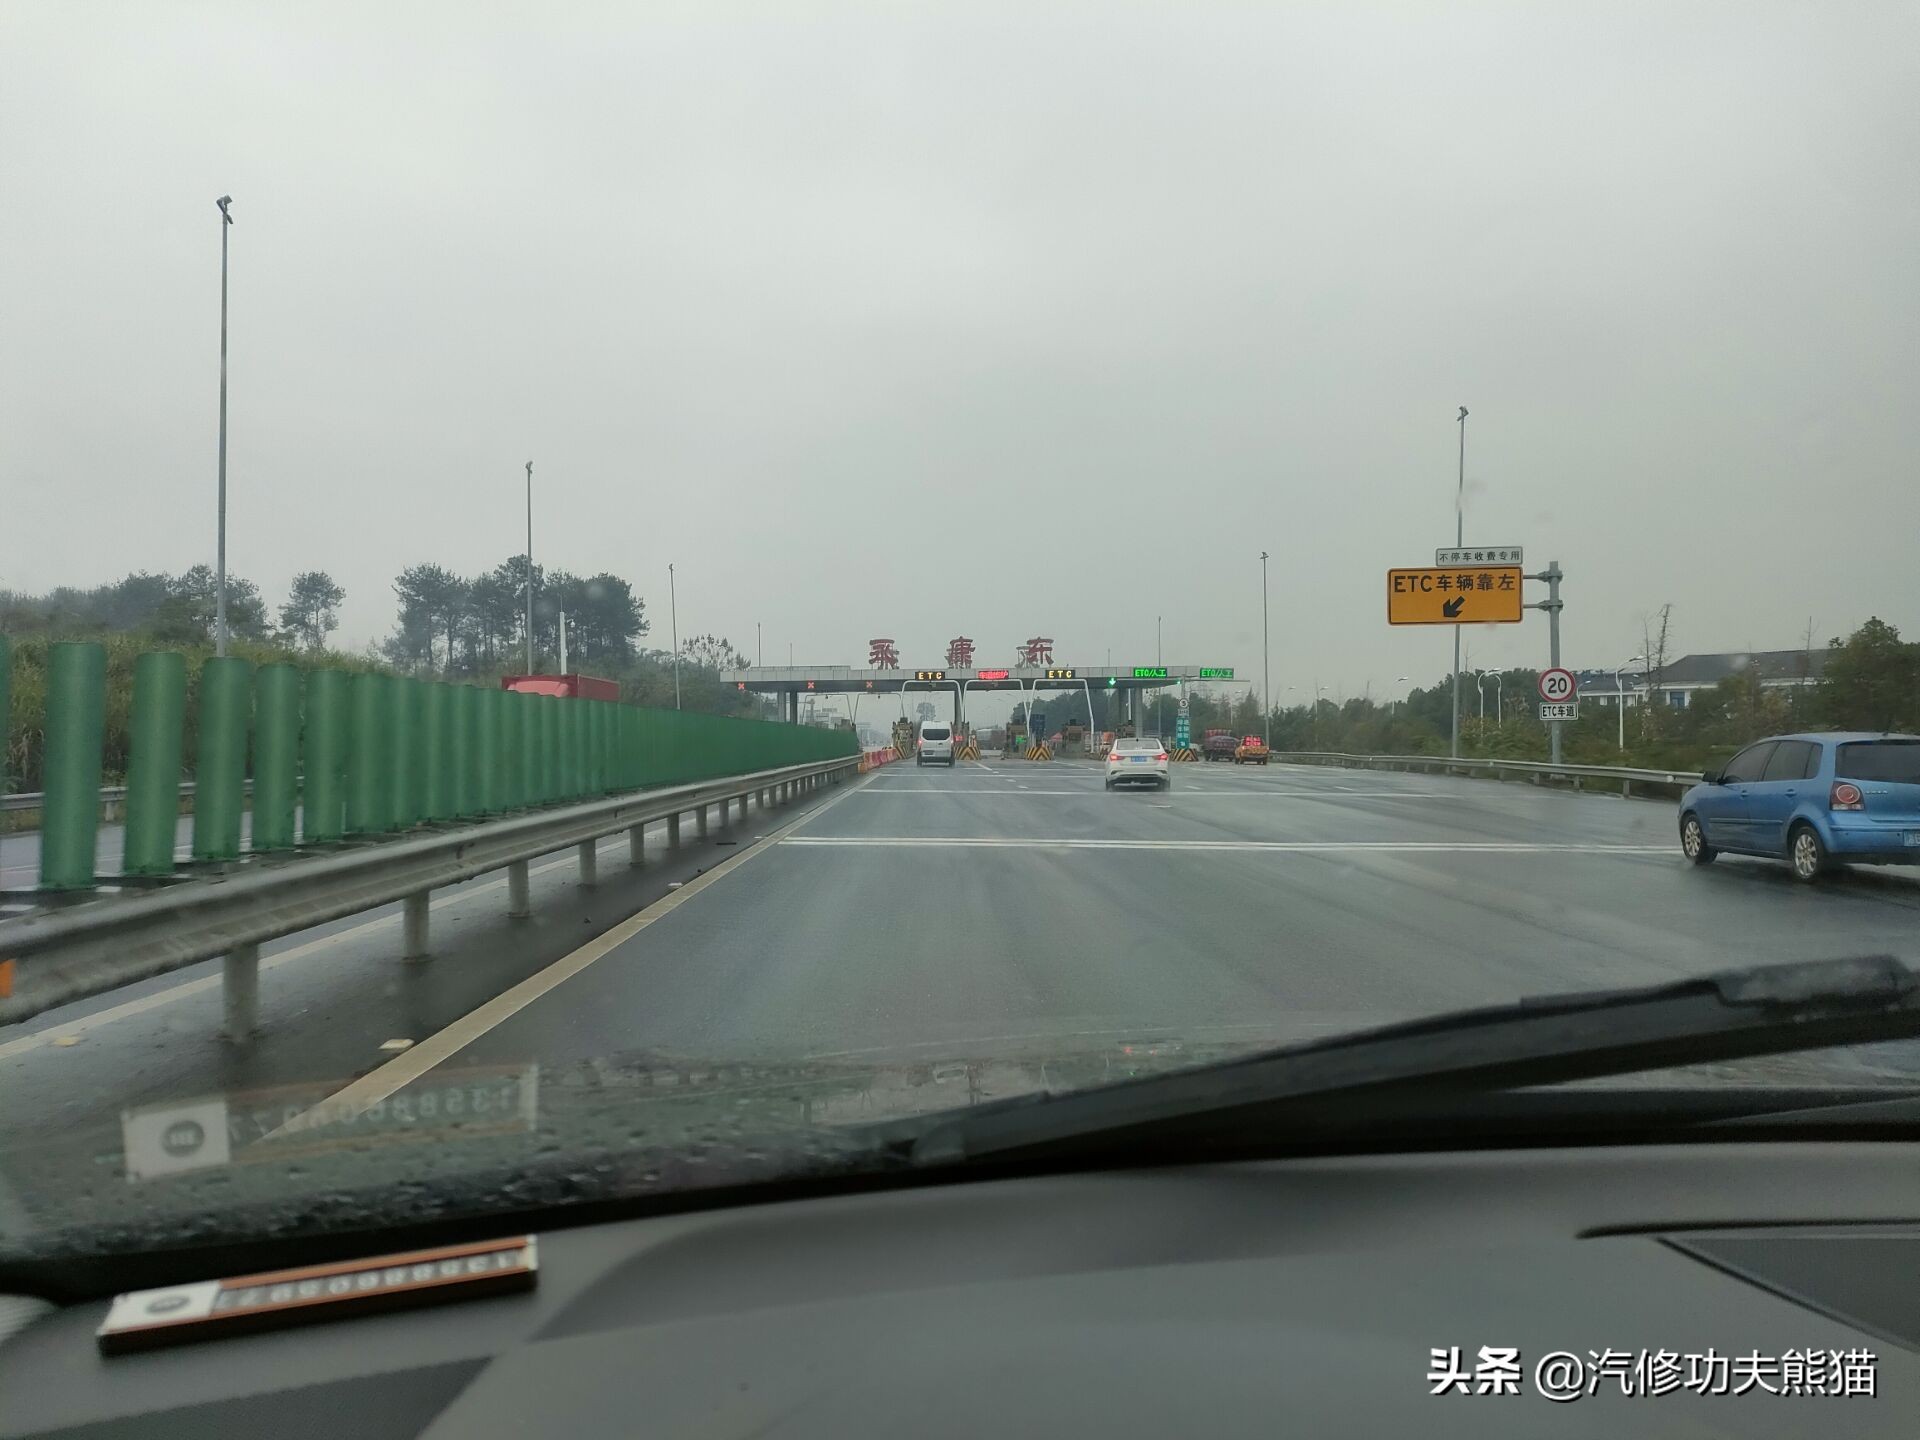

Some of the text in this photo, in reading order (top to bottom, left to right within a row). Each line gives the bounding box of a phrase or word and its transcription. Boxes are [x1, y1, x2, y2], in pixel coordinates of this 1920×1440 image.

[1438, 550, 1521, 563] 不停车收费专用
[1393, 572, 1516, 593] ETC车辆靠左
[917, 672, 943, 680] ETC
[1047, 670, 1073, 679] ETC
[1547, 677, 1568, 694] 20
[1541, 704, 1575, 718] ETC车道
